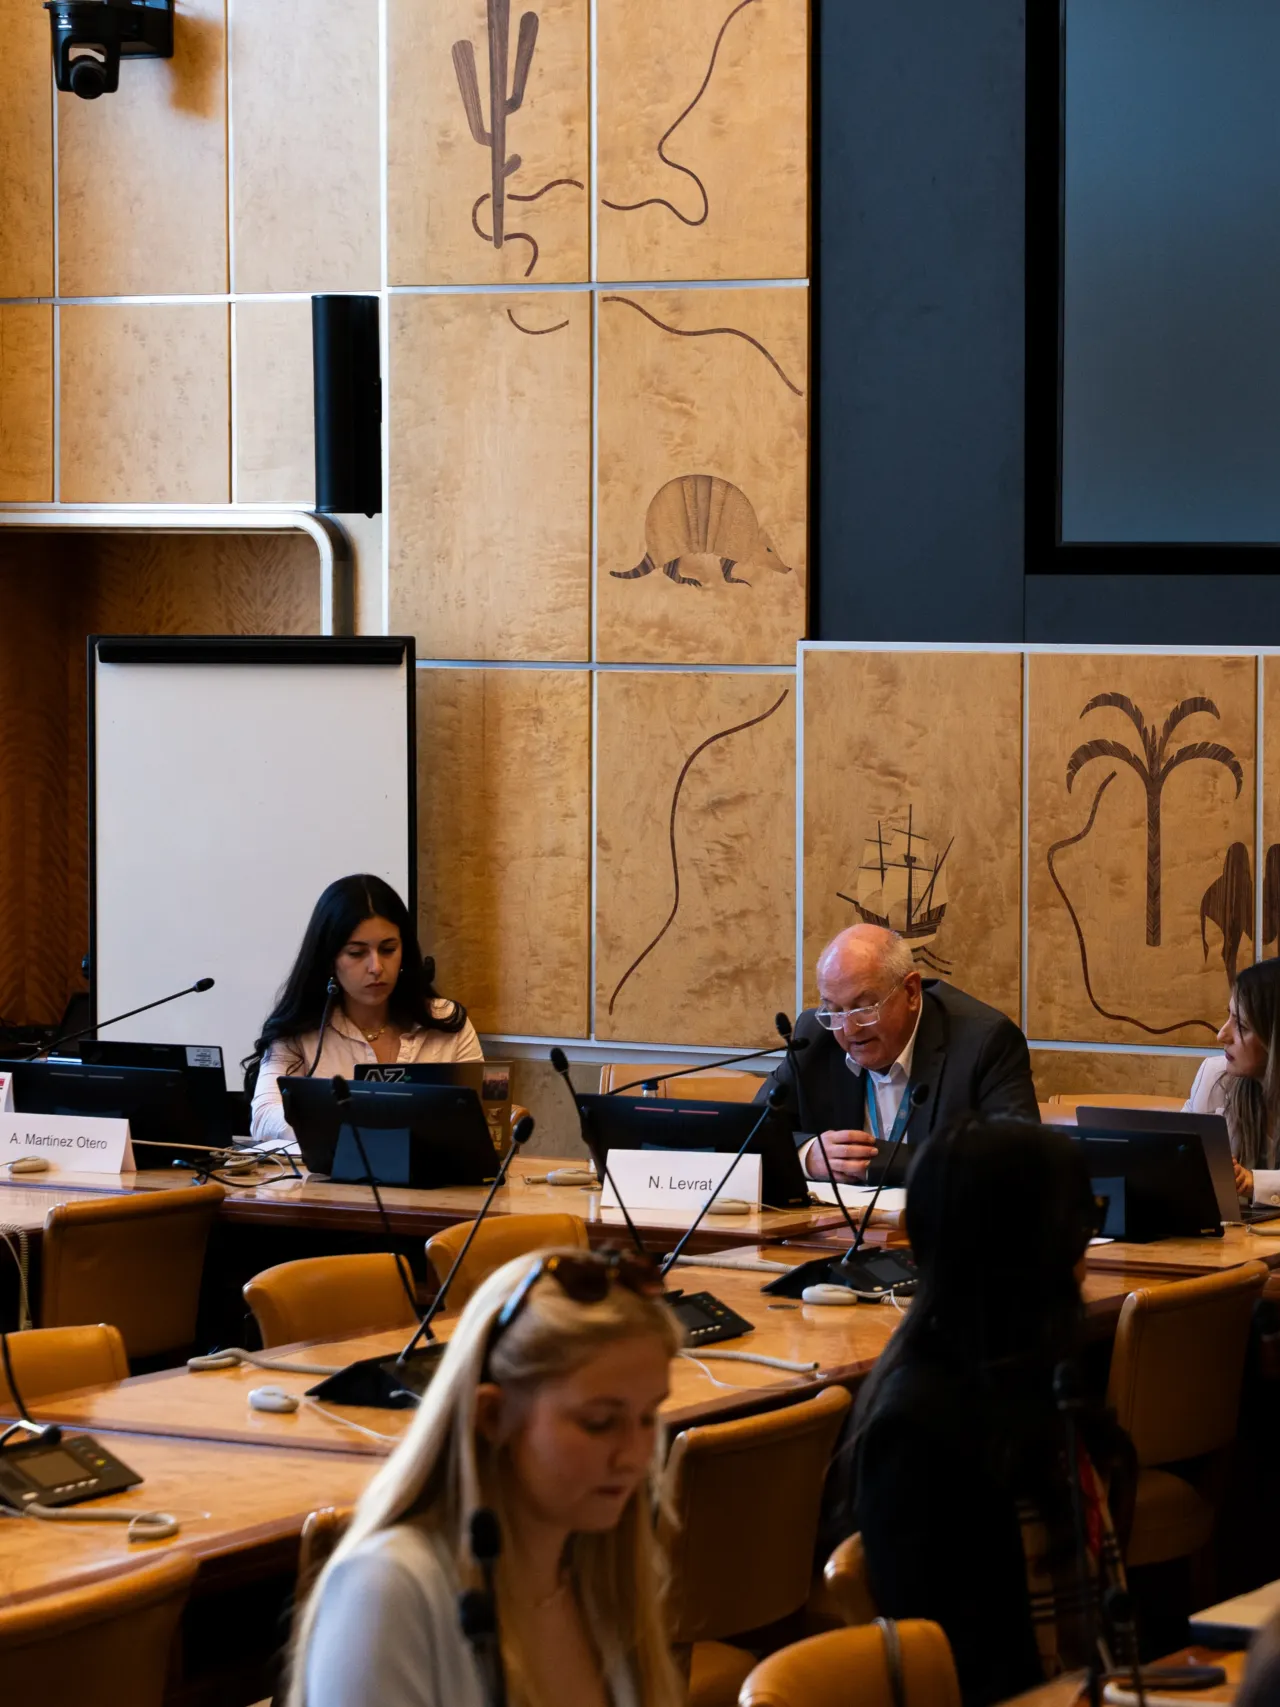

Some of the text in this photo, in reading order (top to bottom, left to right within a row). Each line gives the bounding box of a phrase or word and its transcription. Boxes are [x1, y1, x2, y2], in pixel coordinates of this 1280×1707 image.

[9, 1132, 21, 1145] A.
[76, 1136, 108, 1150] Otero
[648, 1175, 713, 1191] N. Levrat
